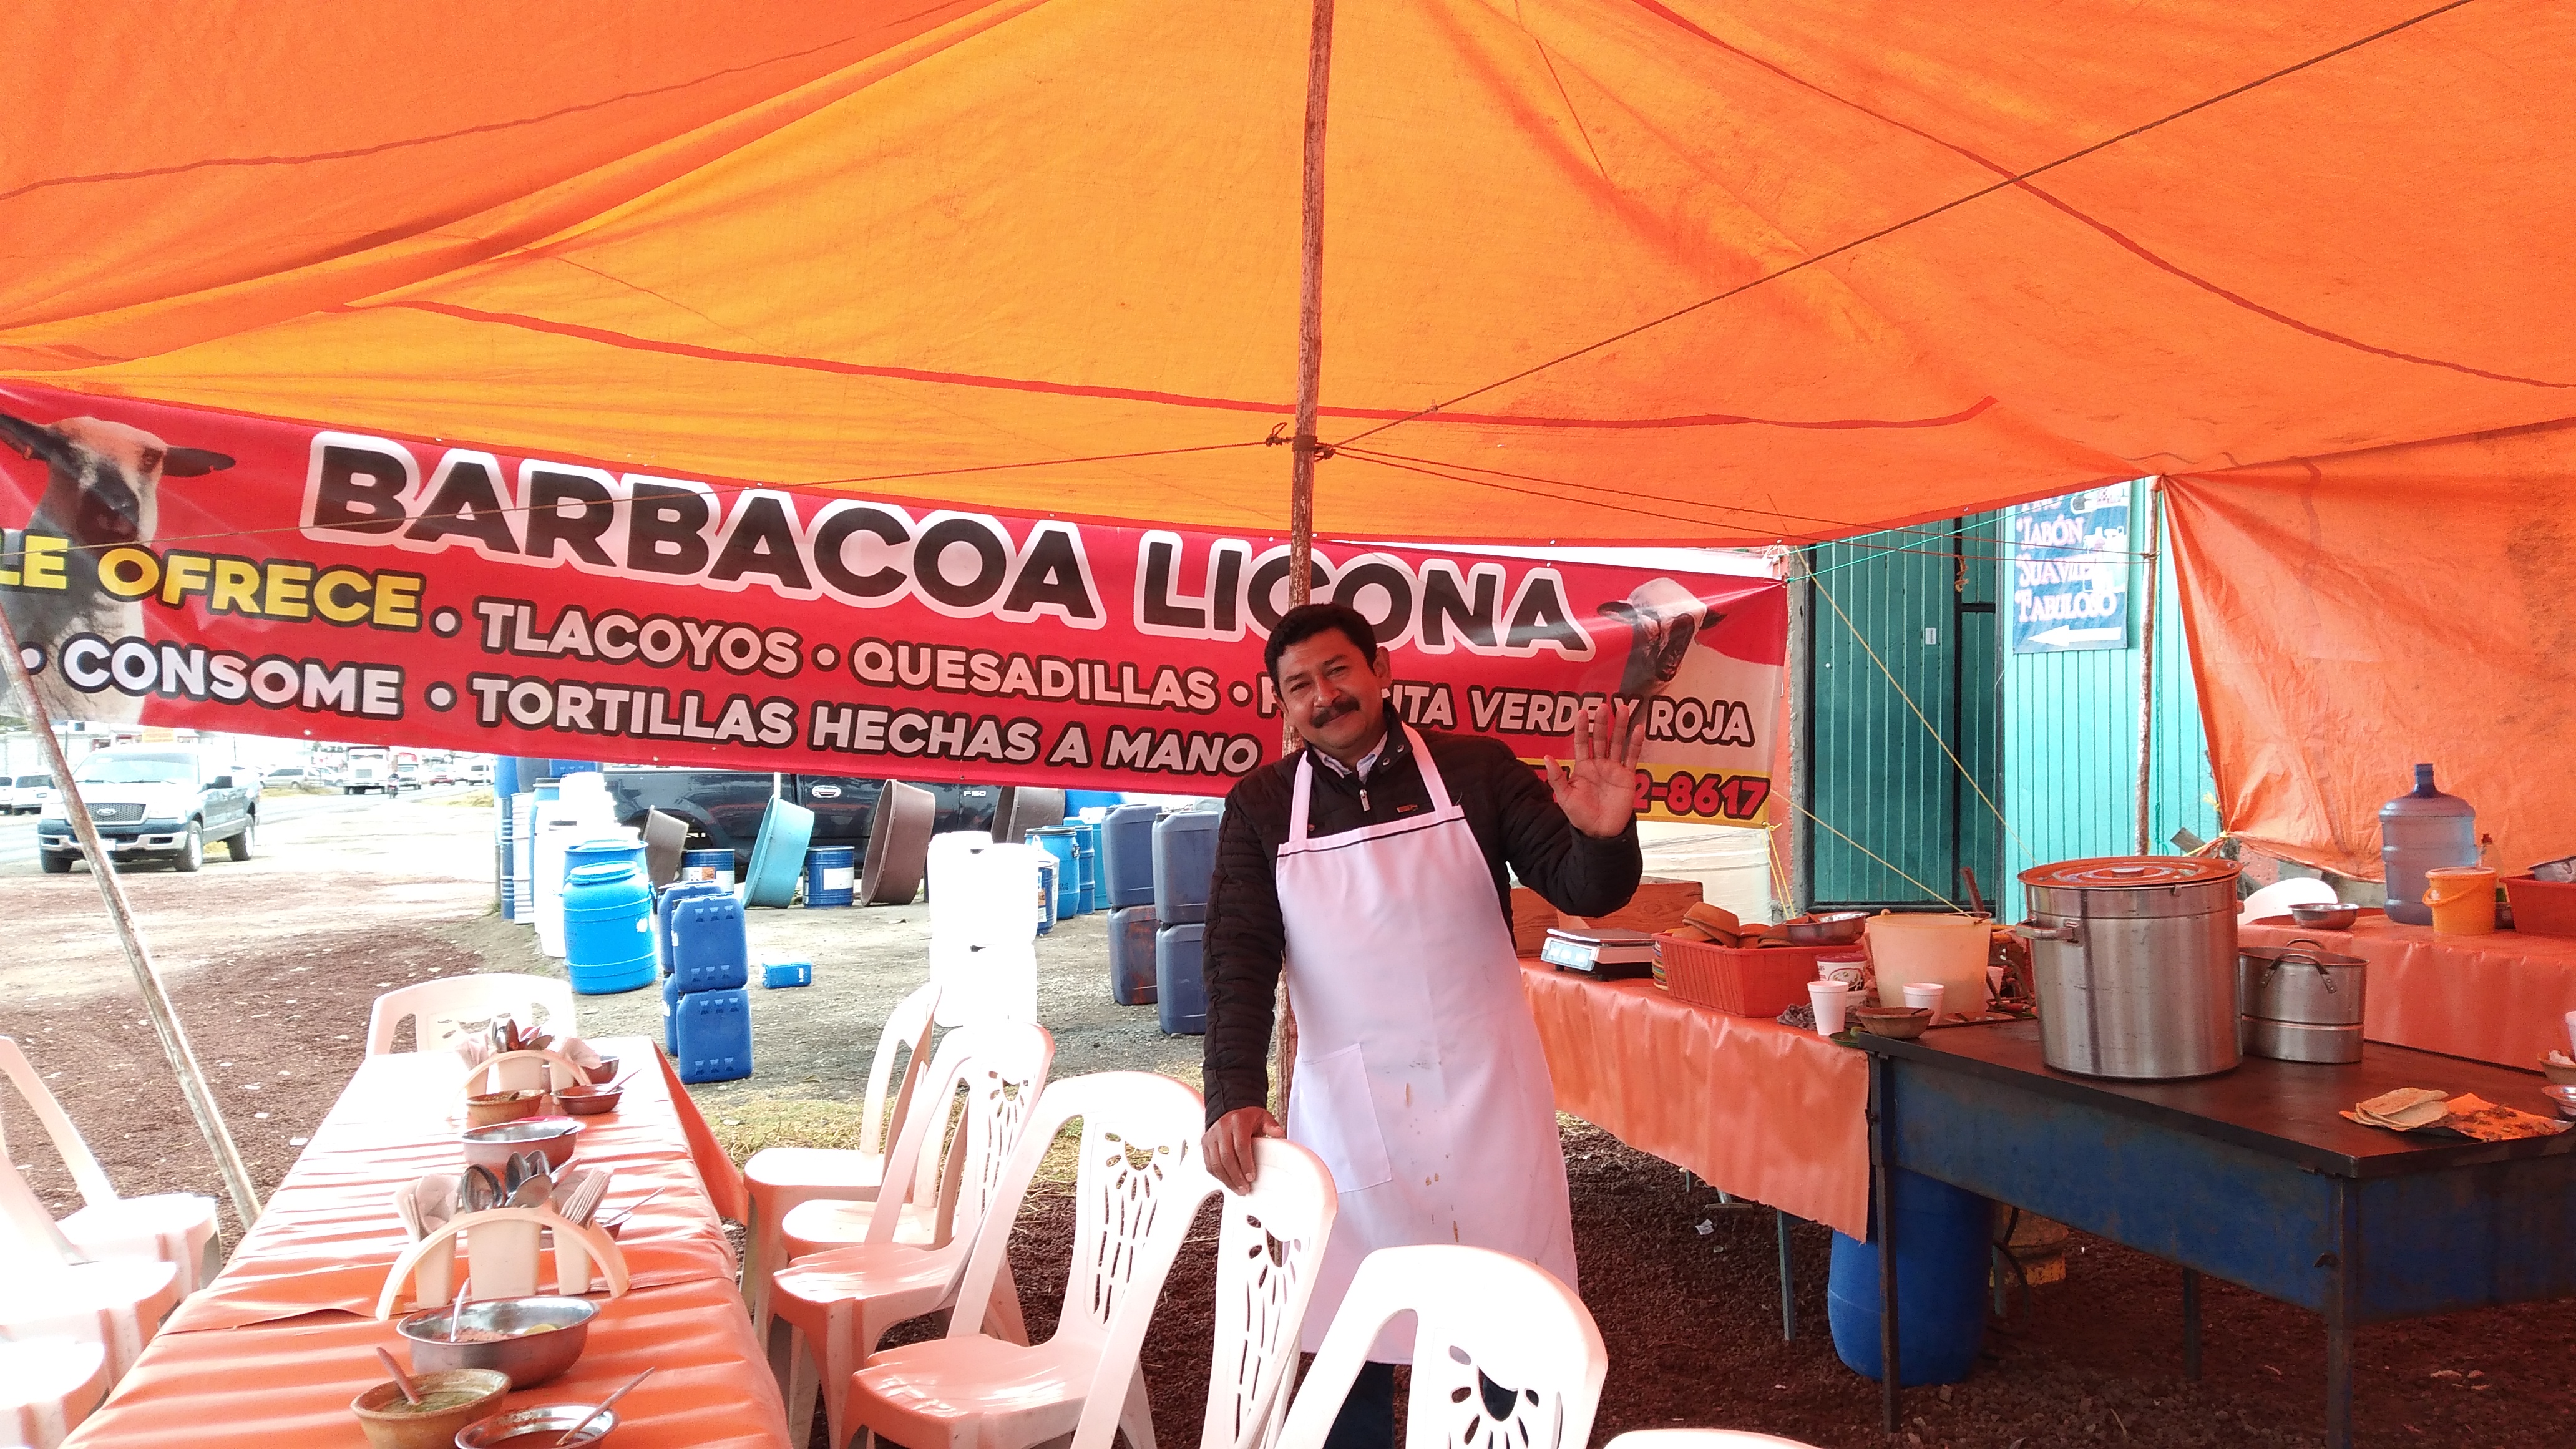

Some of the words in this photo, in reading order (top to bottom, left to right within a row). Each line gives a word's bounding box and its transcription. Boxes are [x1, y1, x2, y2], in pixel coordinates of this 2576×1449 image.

[95, 545, 422, 629] OFRECE
[476, 600, 799, 675] TLACOYOS
[852, 640, 1217, 710] QUESADILLAS
[1470, 688, 1605, 734] VERDE
[1647, 698, 1754, 744] ROJA
[306, 438, 1101, 624] BARBACOA
[1137, 535, 1593, 655] LICONA
[62, 637, 402, 716] CONSOME
[471, 677, 794, 746] TORTILLAS
[811, 705, 1040, 762] HECHAS
[1048, 726, 1090, 766] A
[1105, 731, 1260, 774] MANO
